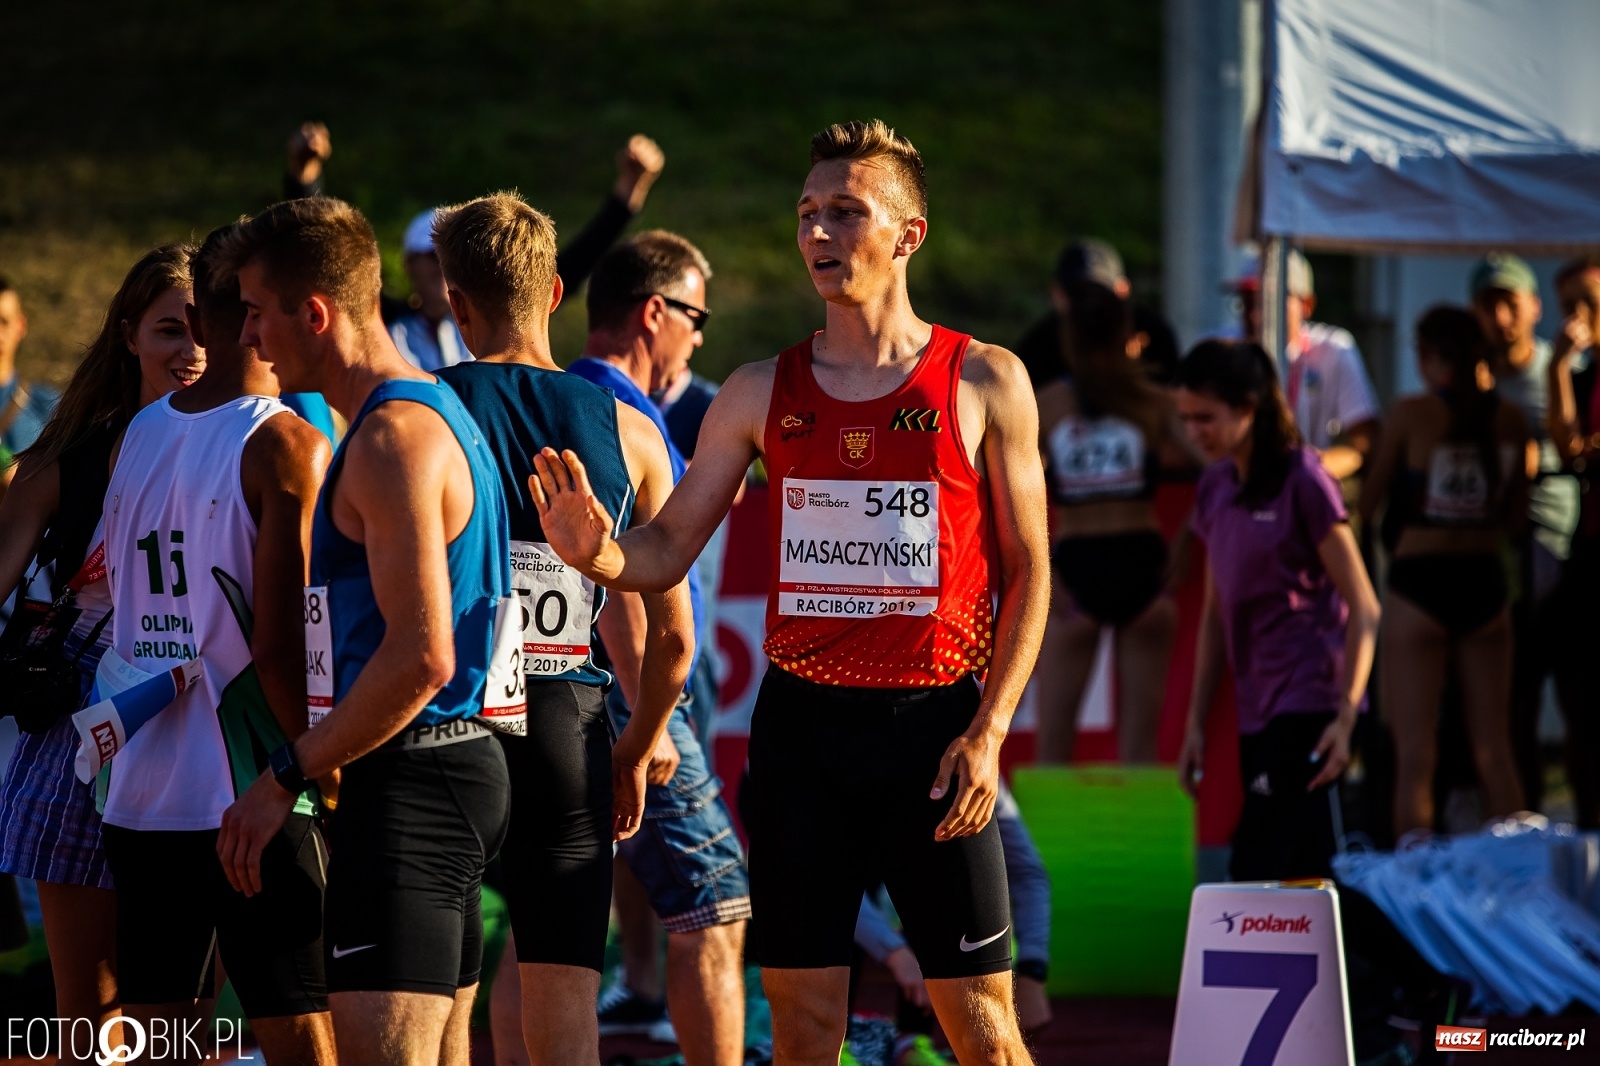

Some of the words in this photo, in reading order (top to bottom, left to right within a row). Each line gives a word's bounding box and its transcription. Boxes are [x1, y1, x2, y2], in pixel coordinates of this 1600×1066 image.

[781, 411, 816, 428] esa
[849, 450, 865, 459] CK
[808, 498, 850, 508] Racibórz
[864, 487, 930, 518] 548
[509, 551, 541, 560] MIASTO
[785, 537, 932, 567] MASACZYŃSKI
[509, 559, 565, 573] Racibórz
[795, 584, 807, 592] 73.
[827, 586, 878, 594] MISTRZOSTWA
[796, 597, 875, 615] RACIBÓRZ
[879, 601, 916, 614] 2019
[306, 650, 327, 676] AK
[534, 658, 568, 672] 2019
[1240, 913, 1313, 936] polanik
[1202, 949, 1319, 1066] 7
